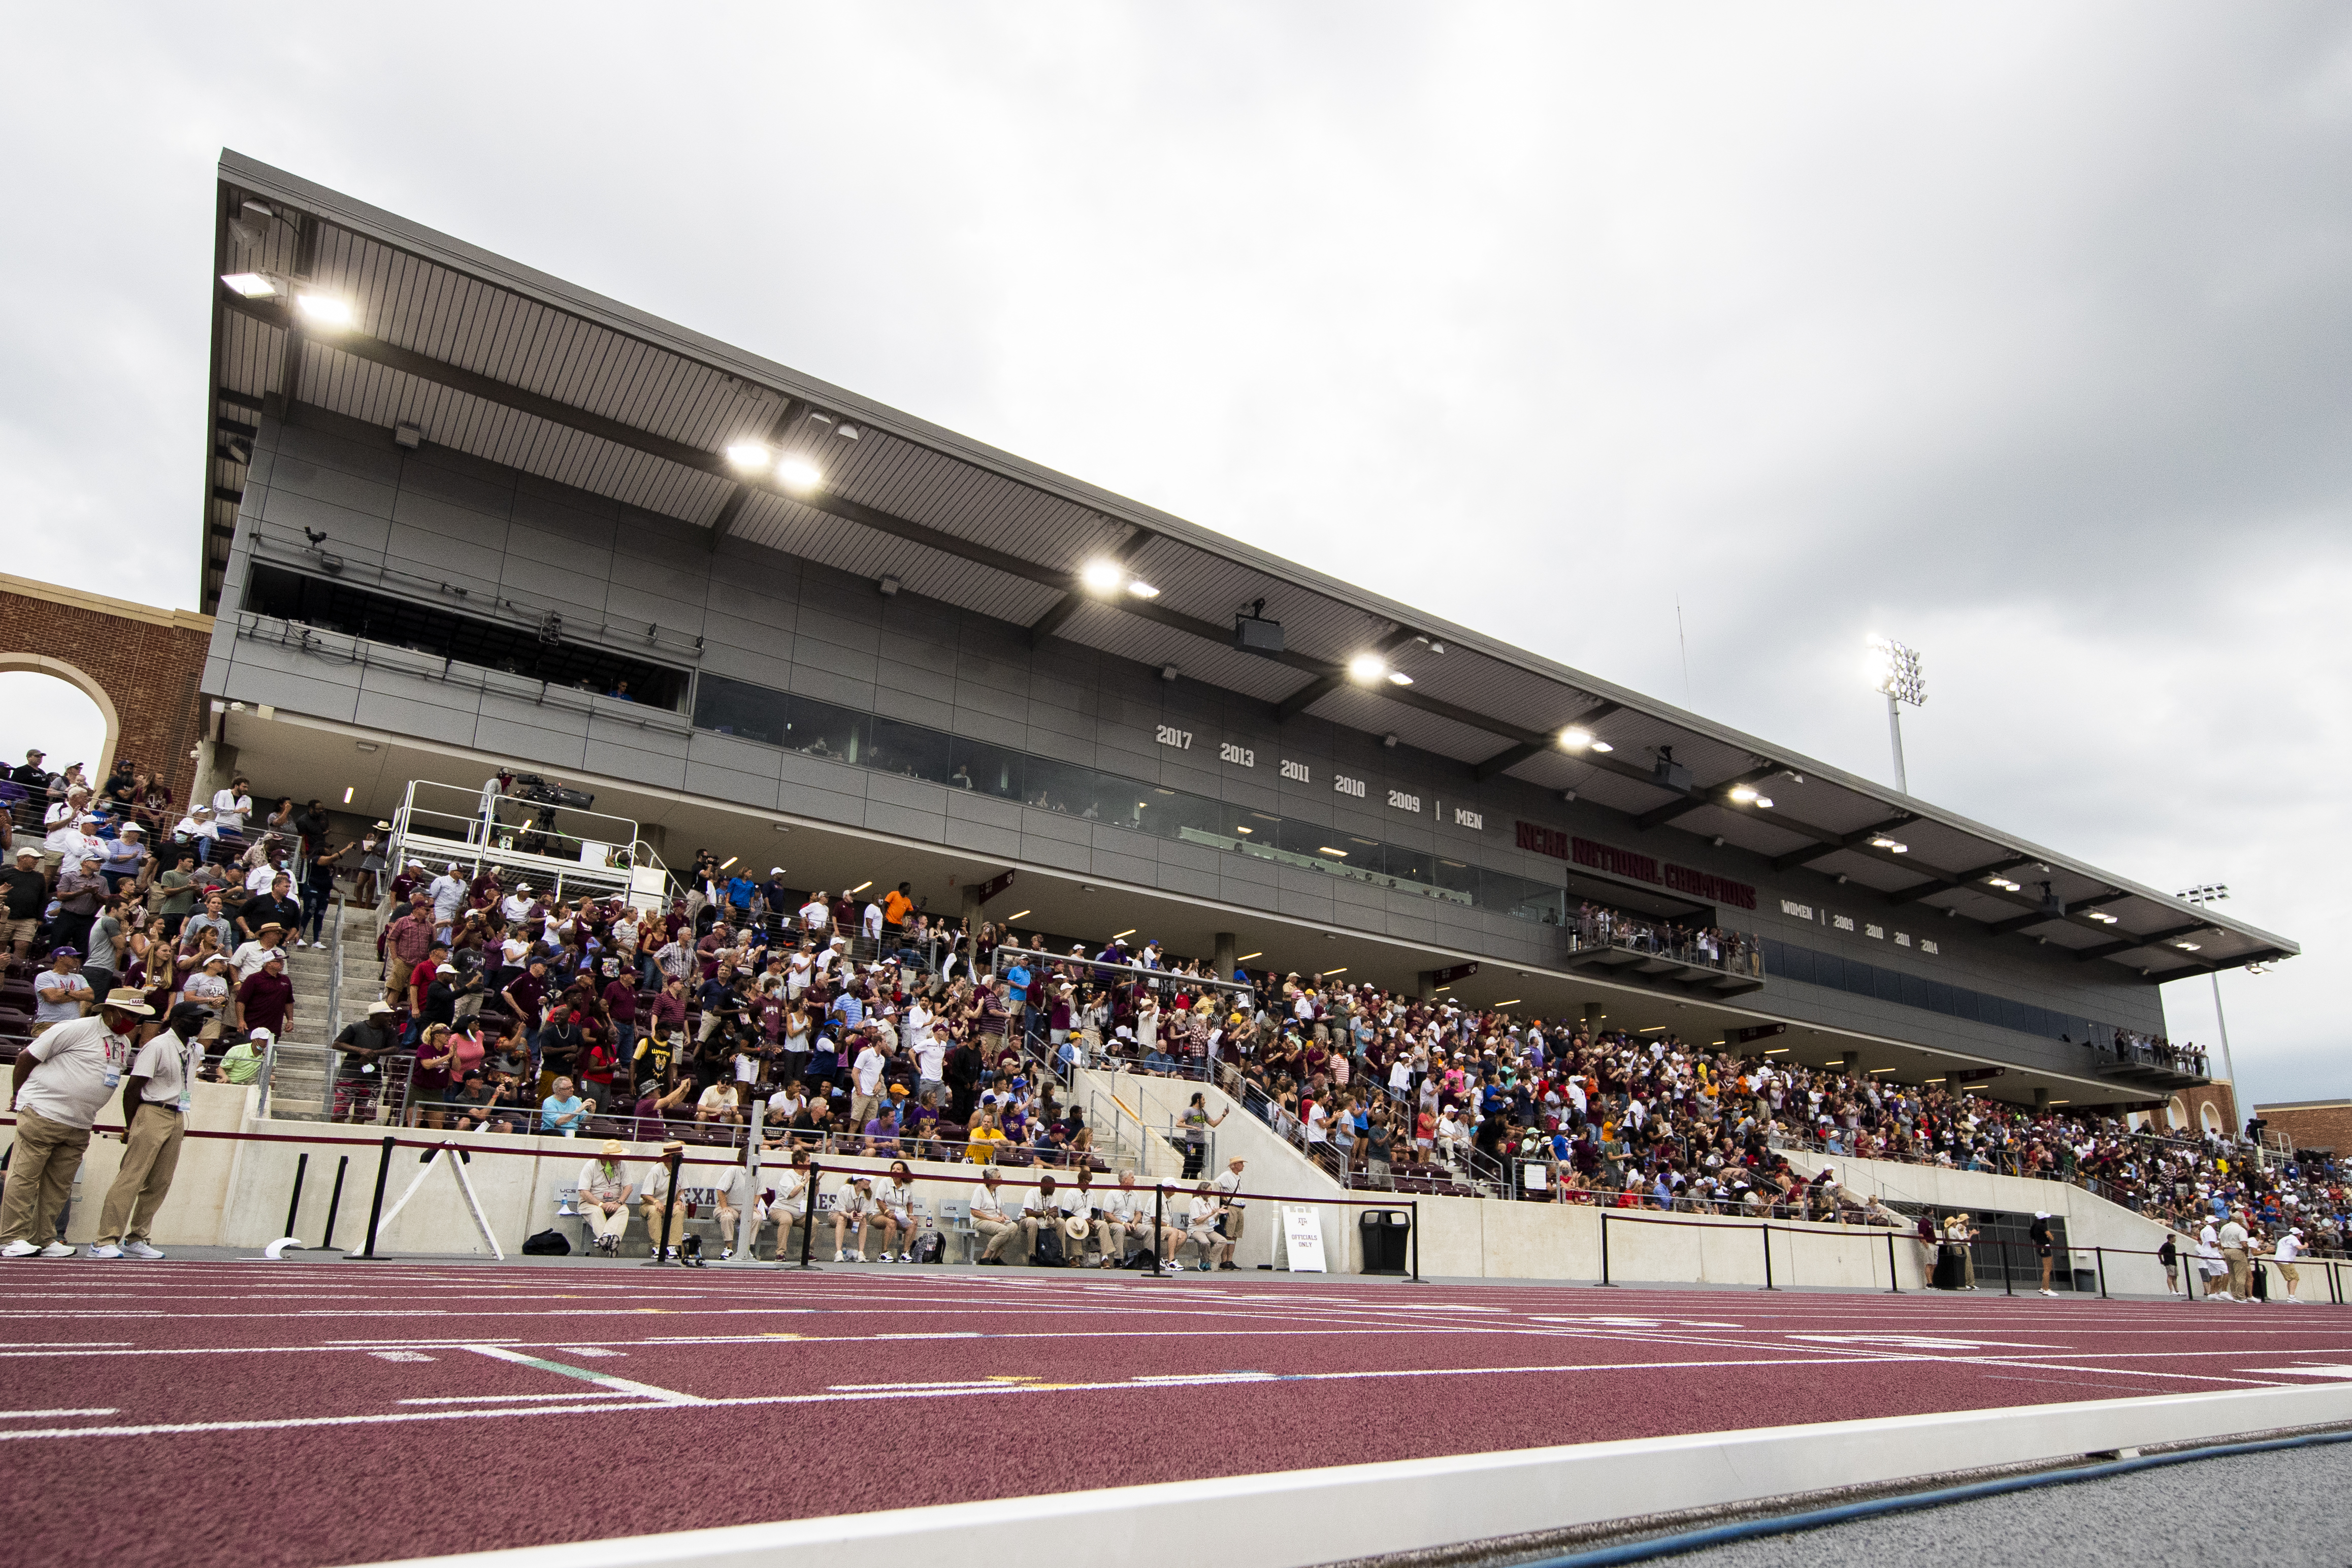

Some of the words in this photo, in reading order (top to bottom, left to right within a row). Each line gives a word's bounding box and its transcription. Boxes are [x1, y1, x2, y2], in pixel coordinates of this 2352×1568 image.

[1156, 725, 1192, 749] 2017
[1220, 742, 1254, 767] 2013
[1280, 760, 1310, 783] 2011
[1334, 775, 1365, 798] 2010
[1388, 790, 1420, 812] 2009
[1455, 808, 1482, 830] MEN
[1516, 821, 1570, 860] NCAA
[1572, 837, 1664, 886] NATIONAL
[1664, 863, 1757, 910] CHAMPIONS
[1780, 899, 1812, 920] WOMEN
[1834, 914, 1853, 931] 2009
[1866, 923, 1883, 939] 2010
[1894, 931, 1910, 947] 2011
[1920, 939, 1938, 955] 2014
